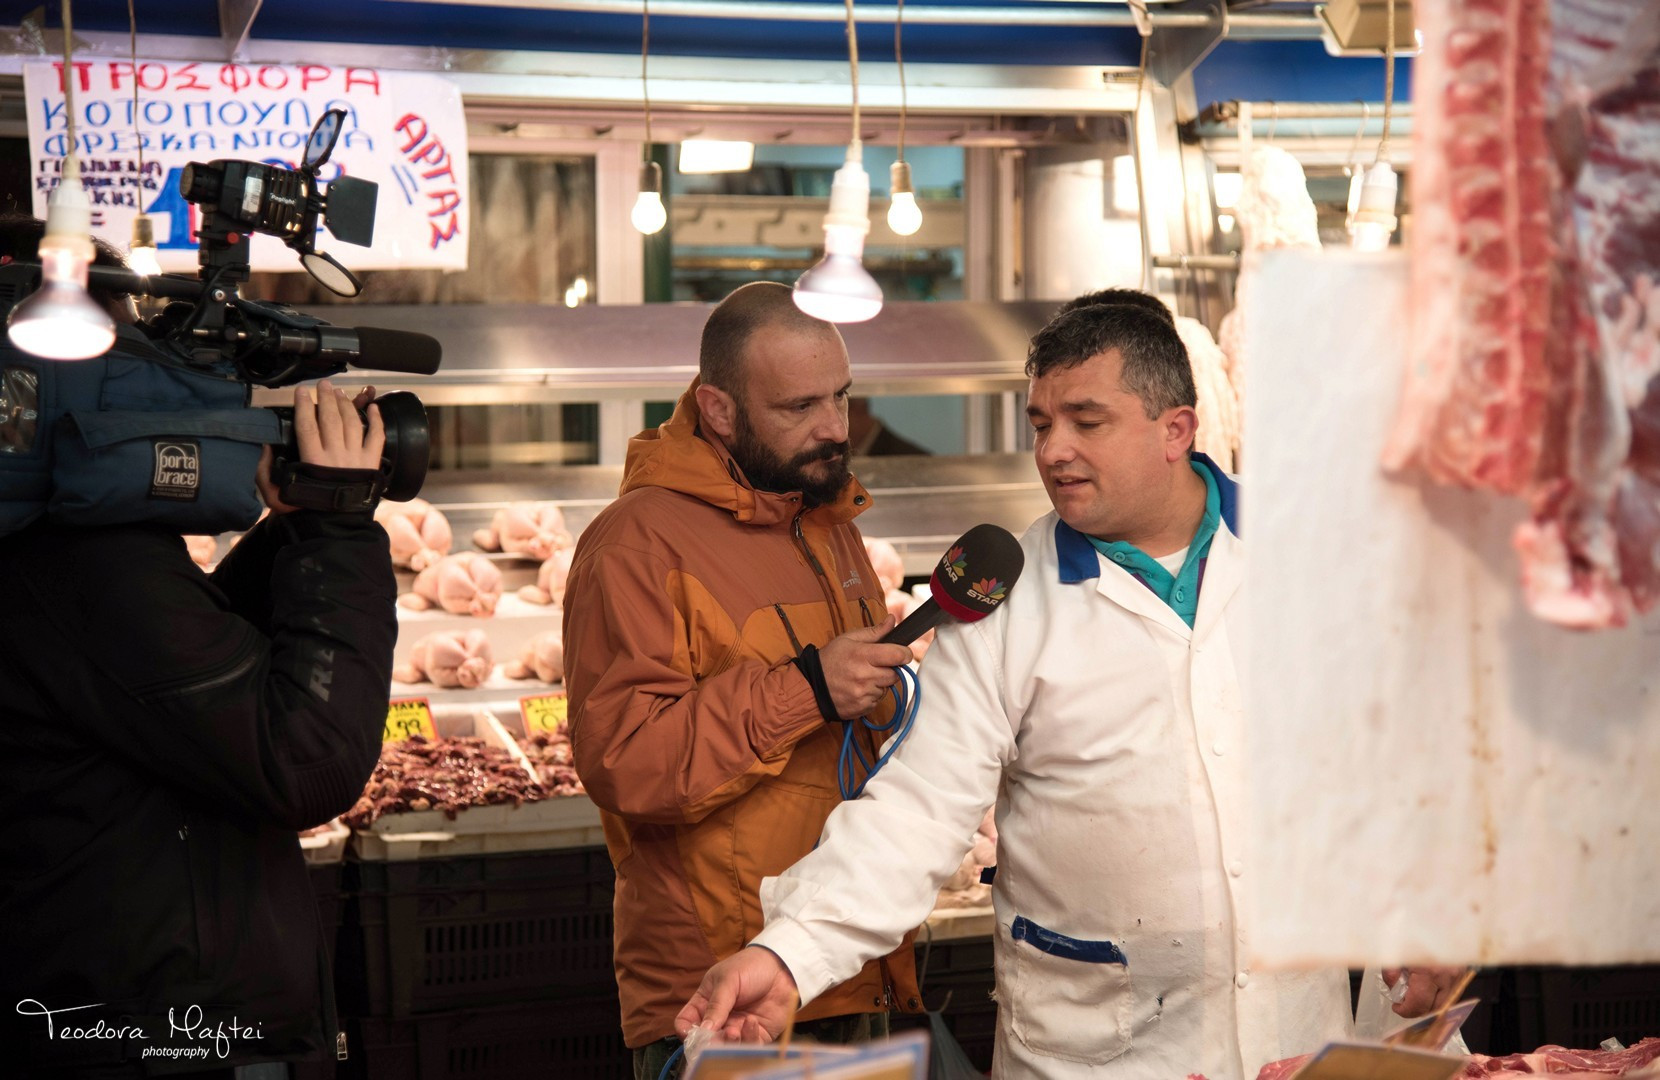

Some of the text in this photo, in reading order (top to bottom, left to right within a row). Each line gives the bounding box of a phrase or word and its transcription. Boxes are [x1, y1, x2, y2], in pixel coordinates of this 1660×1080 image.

[52, 61, 380, 95] ΠΡΟΣΦΟΡΑ
[43, 98, 358, 131] ΚΟΤΟΠΟΥΛΑ
[394, 113, 461, 249] ΑΡΤΑΣ
[160, 455, 196, 470] porta
[157, 470, 196, 486] brace
[942, 554, 959, 584] STAR
[966, 588, 999, 606] STAR
